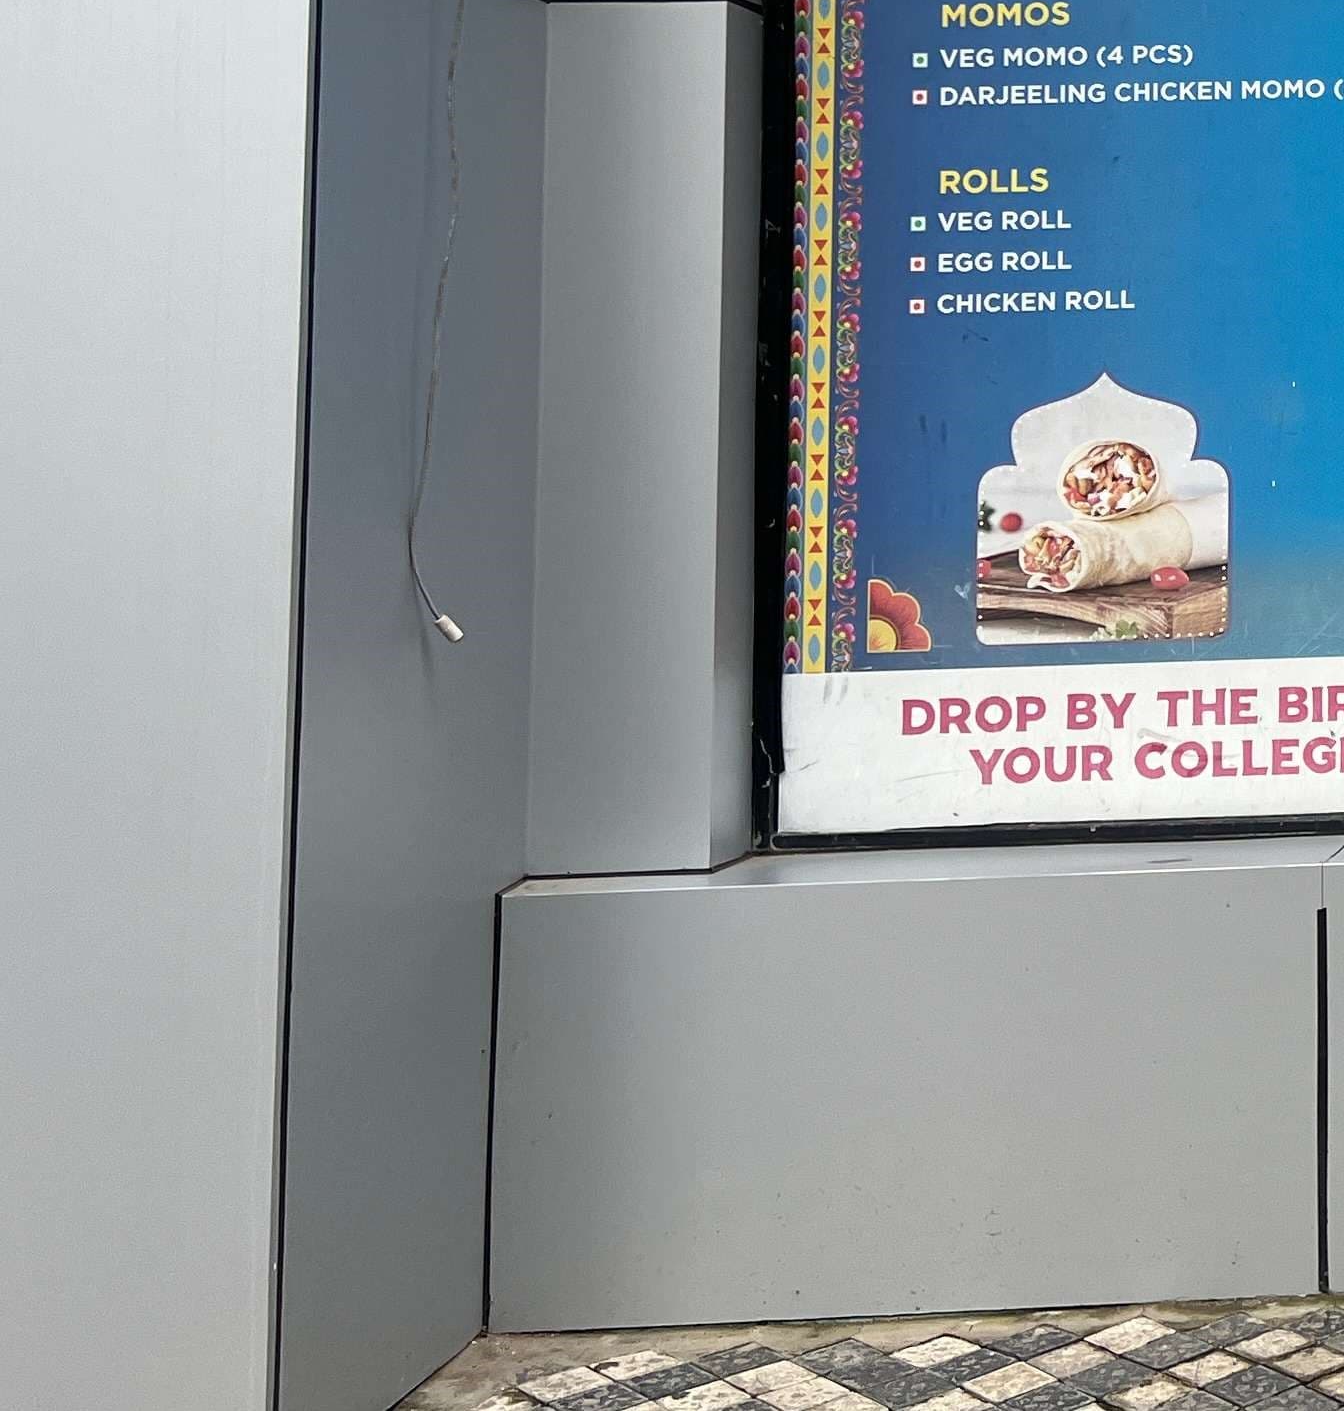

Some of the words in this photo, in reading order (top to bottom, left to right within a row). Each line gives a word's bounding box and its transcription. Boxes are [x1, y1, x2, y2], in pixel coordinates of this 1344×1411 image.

[941, 1, 1070, 28] MOMOS
[939, 47, 995, 68] VEG
[1003, 46, 1088, 67] MOMO
[1096, 45, 1124, 68] (4
[1132, 44, 1194, 66] PCS)
[940, 83, 1106, 106] DARJEELING
[1114, 80, 1232, 102] CHICKEN
[1241, 78, 1326, 100] MOMO
[939, 167, 1049, 194] ROLLS
[937, 211, 993, 232] VEG
[1001, 209, 1072, 231] ROLL
[938, 252, 993, 273] EGG
[1002, 250, 1073, 271] ROLL
[937, 291, 1056, 314] CHICKEN
[1065, 289, 1136, 311] ROLL
[901, 695, 1047, 736] DROP
[1066, 692, 1137, 731] BY
[1156, 687, 1259, 728] THE
[968, 744, 1113, 786] YOUR
